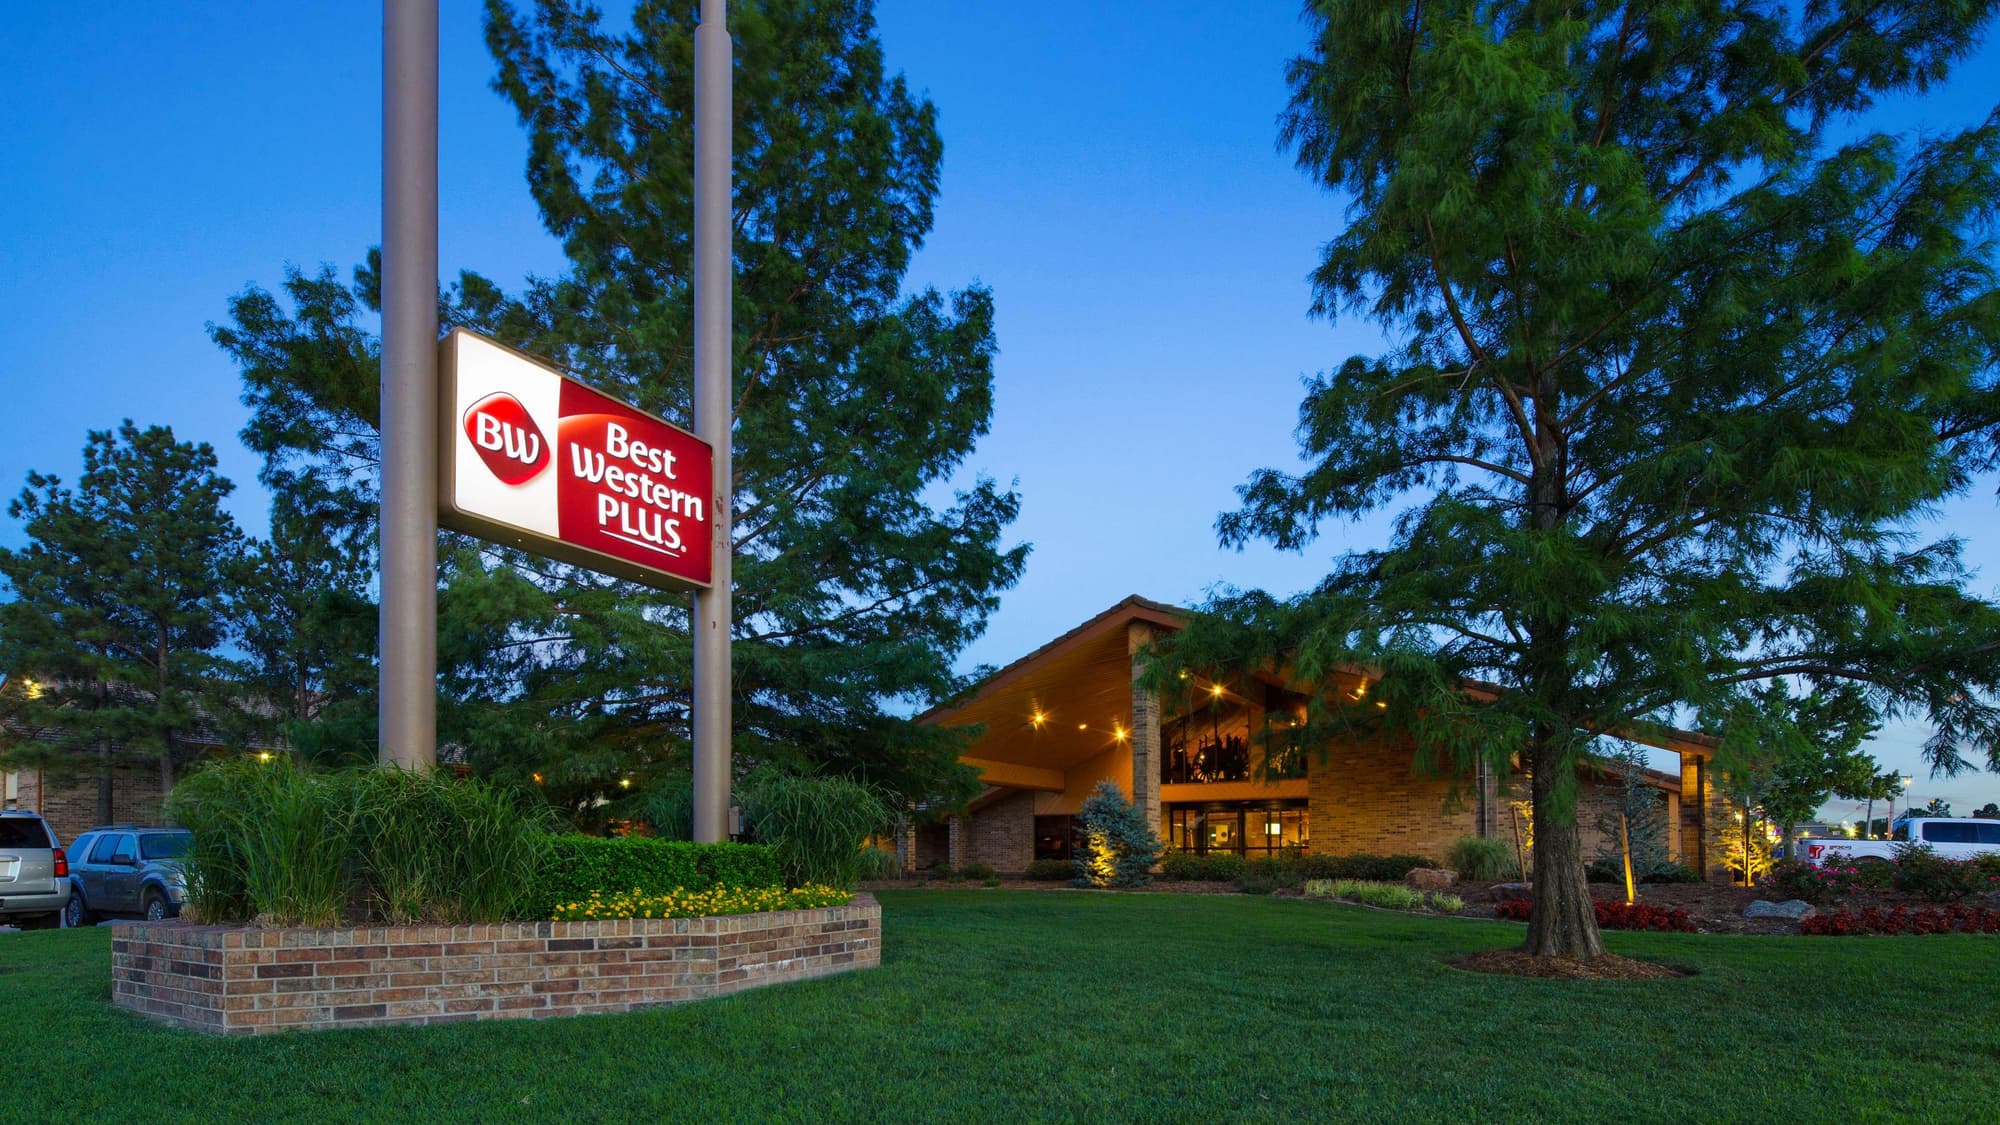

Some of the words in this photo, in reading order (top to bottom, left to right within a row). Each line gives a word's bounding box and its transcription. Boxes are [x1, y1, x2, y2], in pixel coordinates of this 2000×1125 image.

[476, 411, 539, 464] BW
[606, 422, 677, 480] Best
[570, 442, 704, 521] Western
